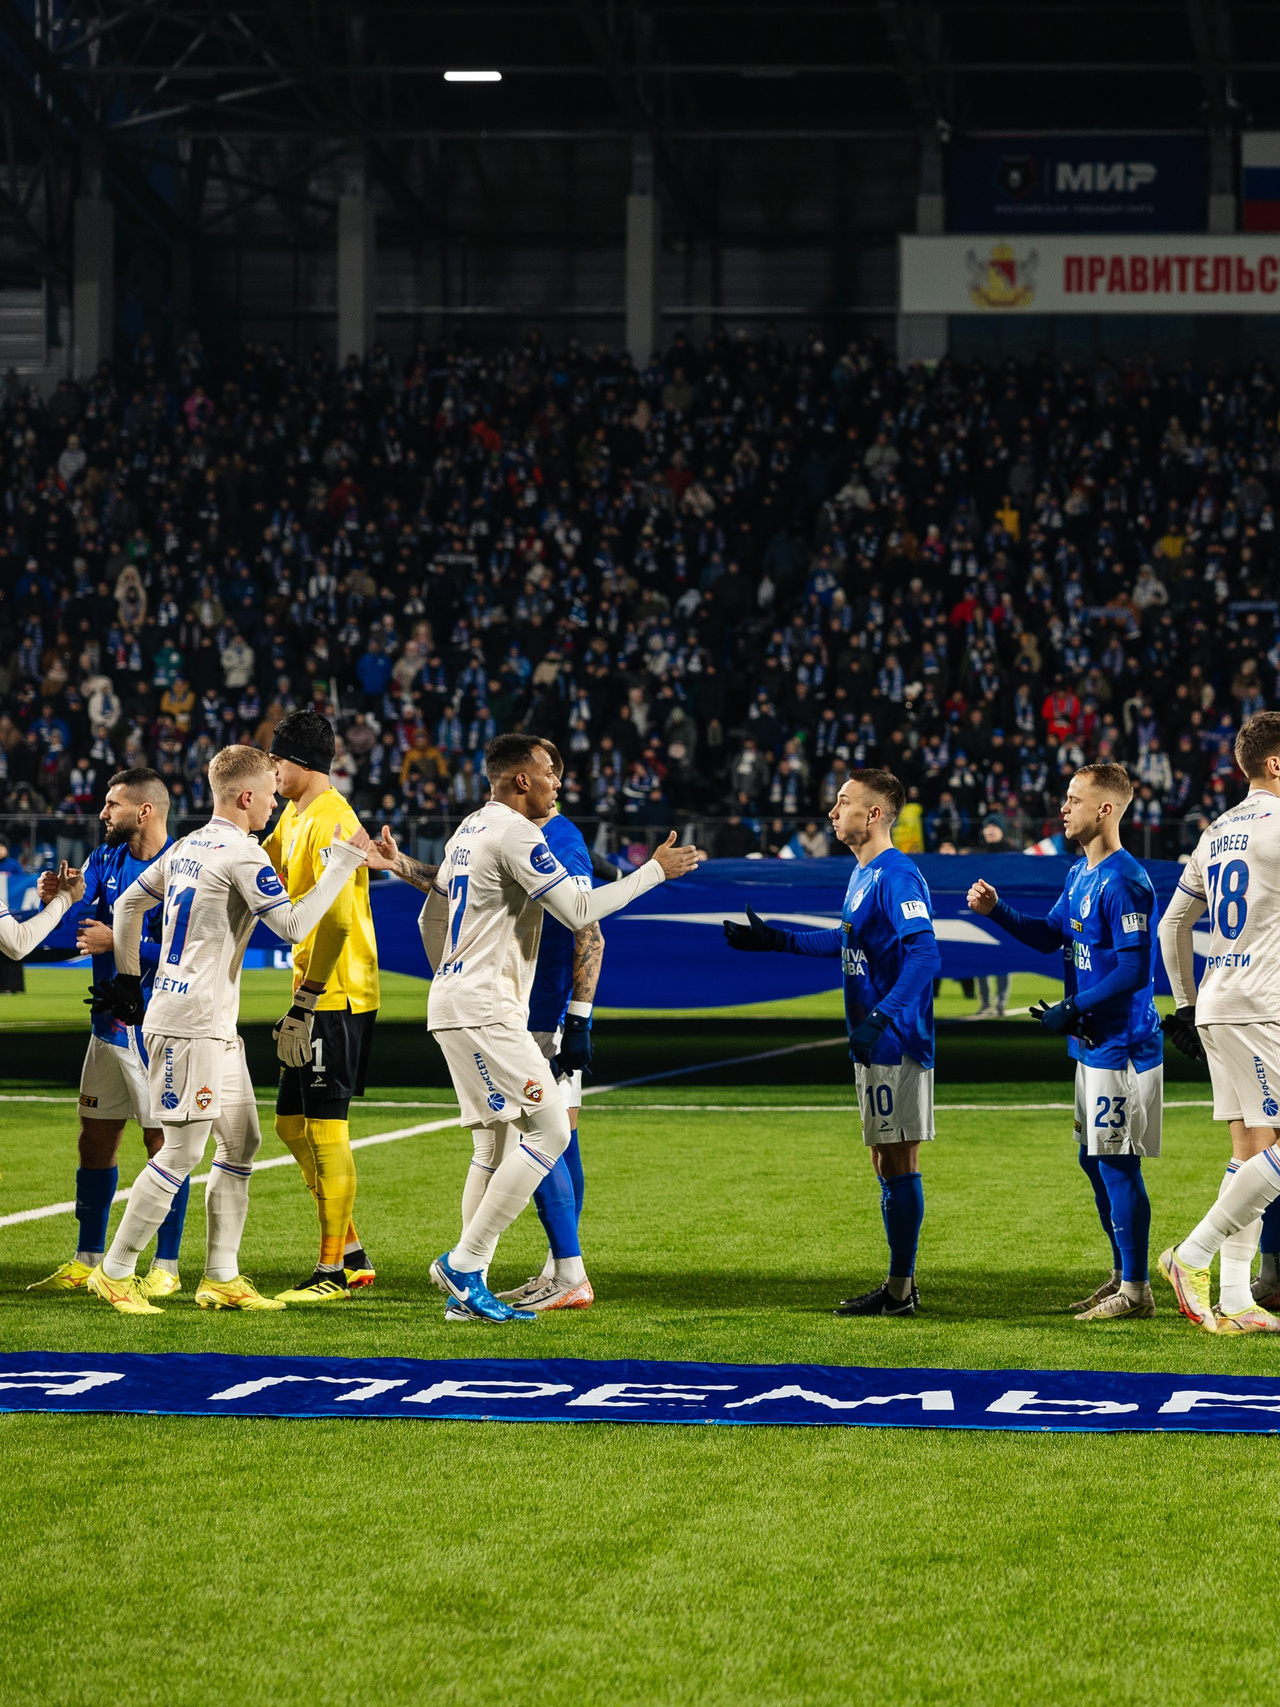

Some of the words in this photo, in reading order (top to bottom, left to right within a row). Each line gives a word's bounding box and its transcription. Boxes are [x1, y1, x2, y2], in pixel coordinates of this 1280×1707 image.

[1055, 161, 1157, 193] МИР
[1210, 834, 1249, 858] ДИВЕЕВ
[1207, 859, 1250, 940] 78
[165, 1048, 174, 1089] РОССЕТИ
[311, 1038, 326, 1072] 1
[473, 1052, 496, 1092] РОССЕТИ
[1253, 1056, 1271, 1096] РОССЕТИ
[866, 1084, 894, 1117] 10
[1094, 1096, 1127, 1129] 23
